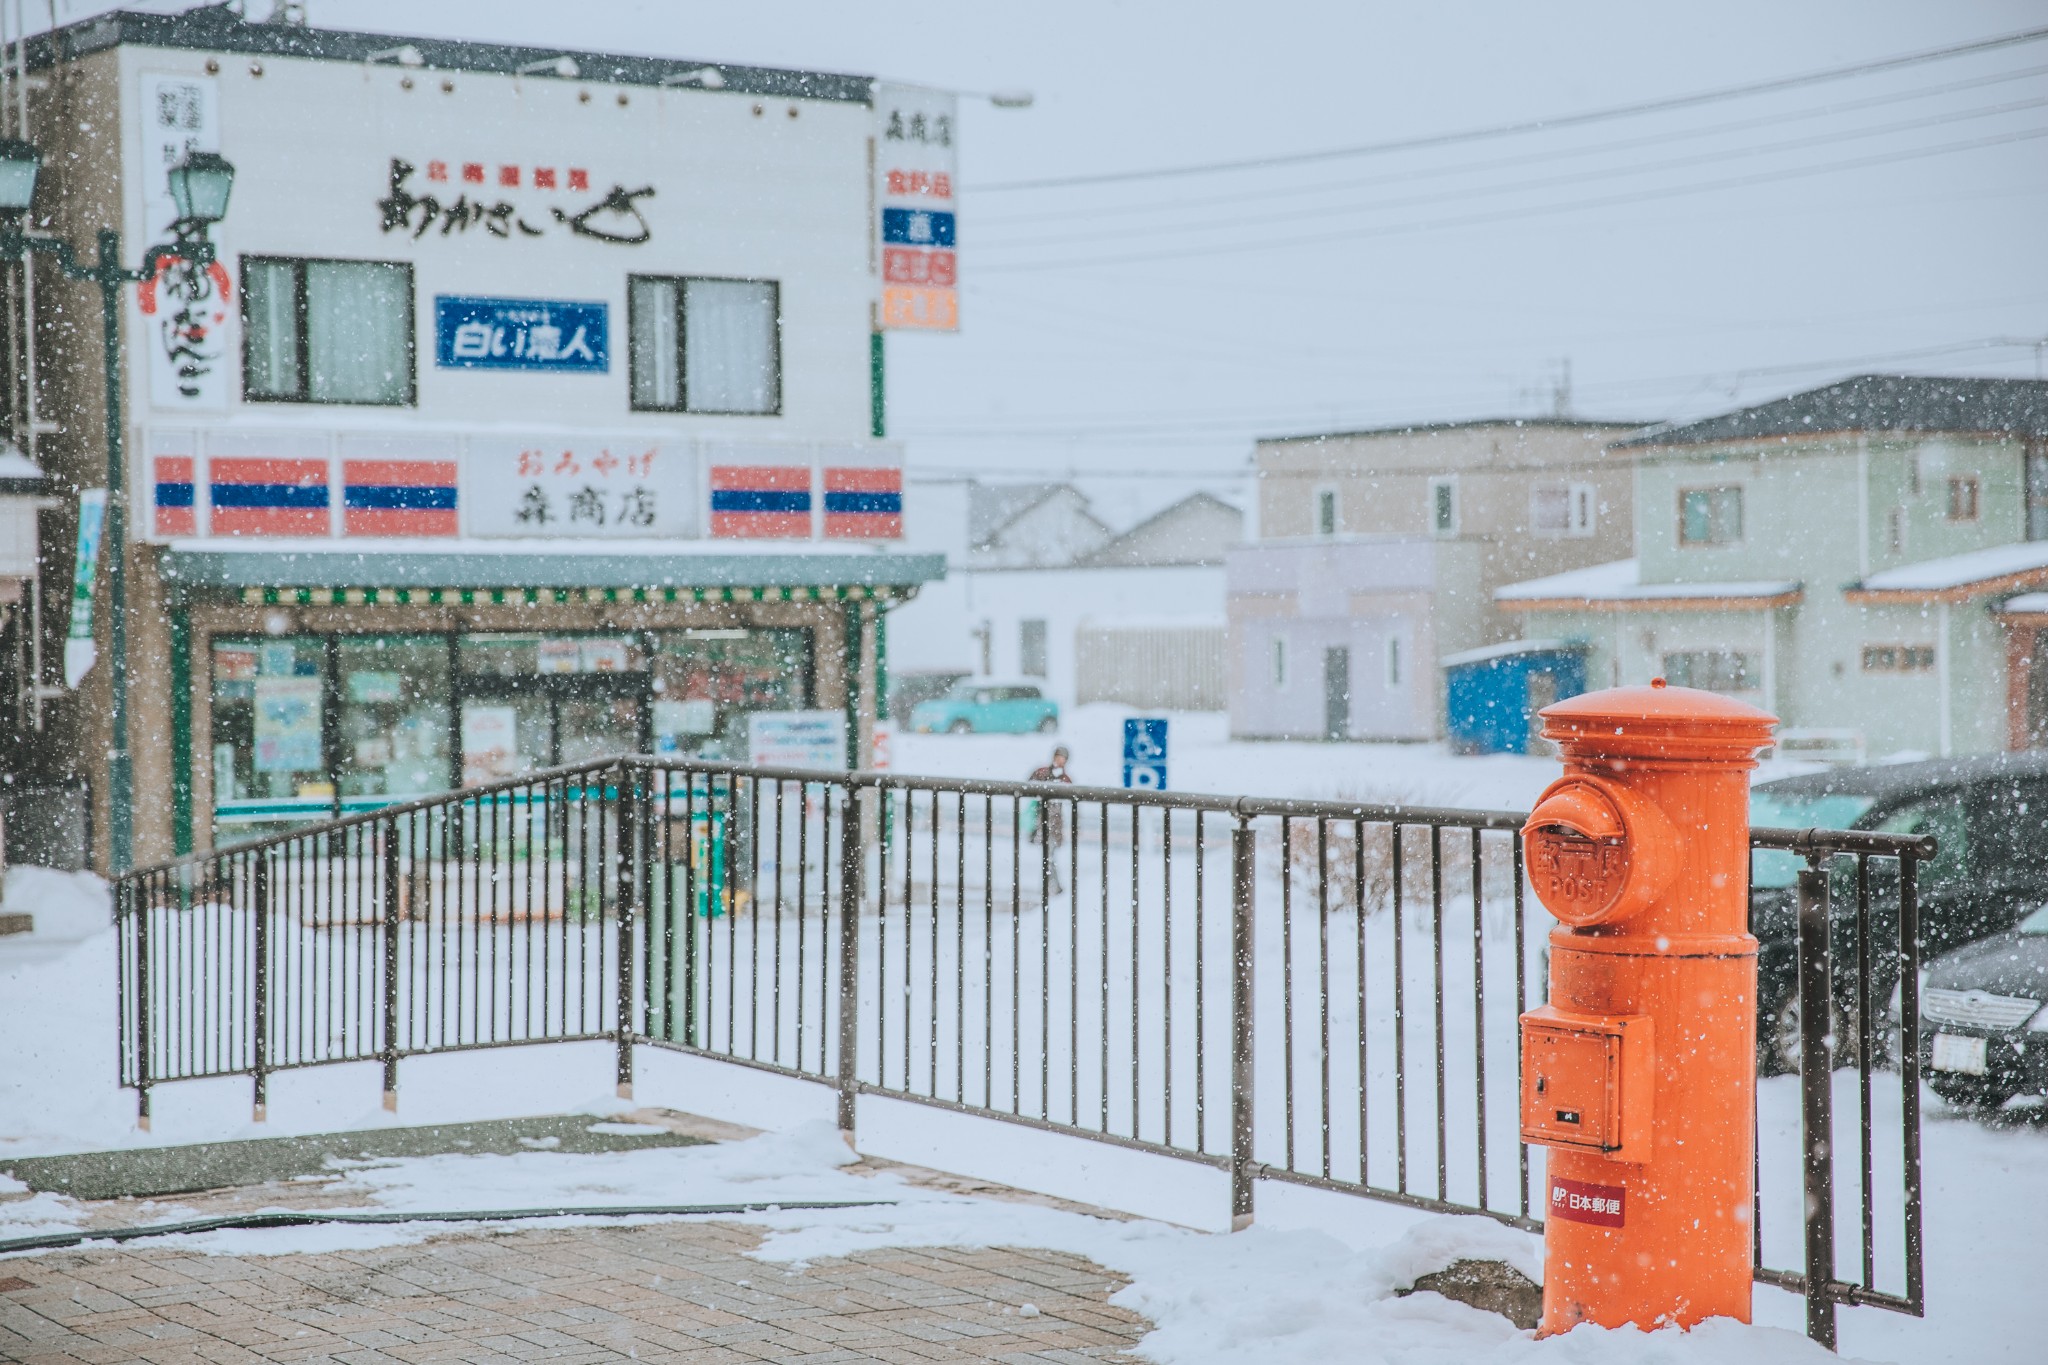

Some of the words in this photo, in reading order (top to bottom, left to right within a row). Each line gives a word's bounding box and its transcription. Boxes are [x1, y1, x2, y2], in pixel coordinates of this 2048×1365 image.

[516, 446, 658, 478] おみやげ
[514, 483, 658, 526] 森商店
[1548, 877, 1609, 901] POST
[1569, 1193, 1621, 1215] 日本郵便
